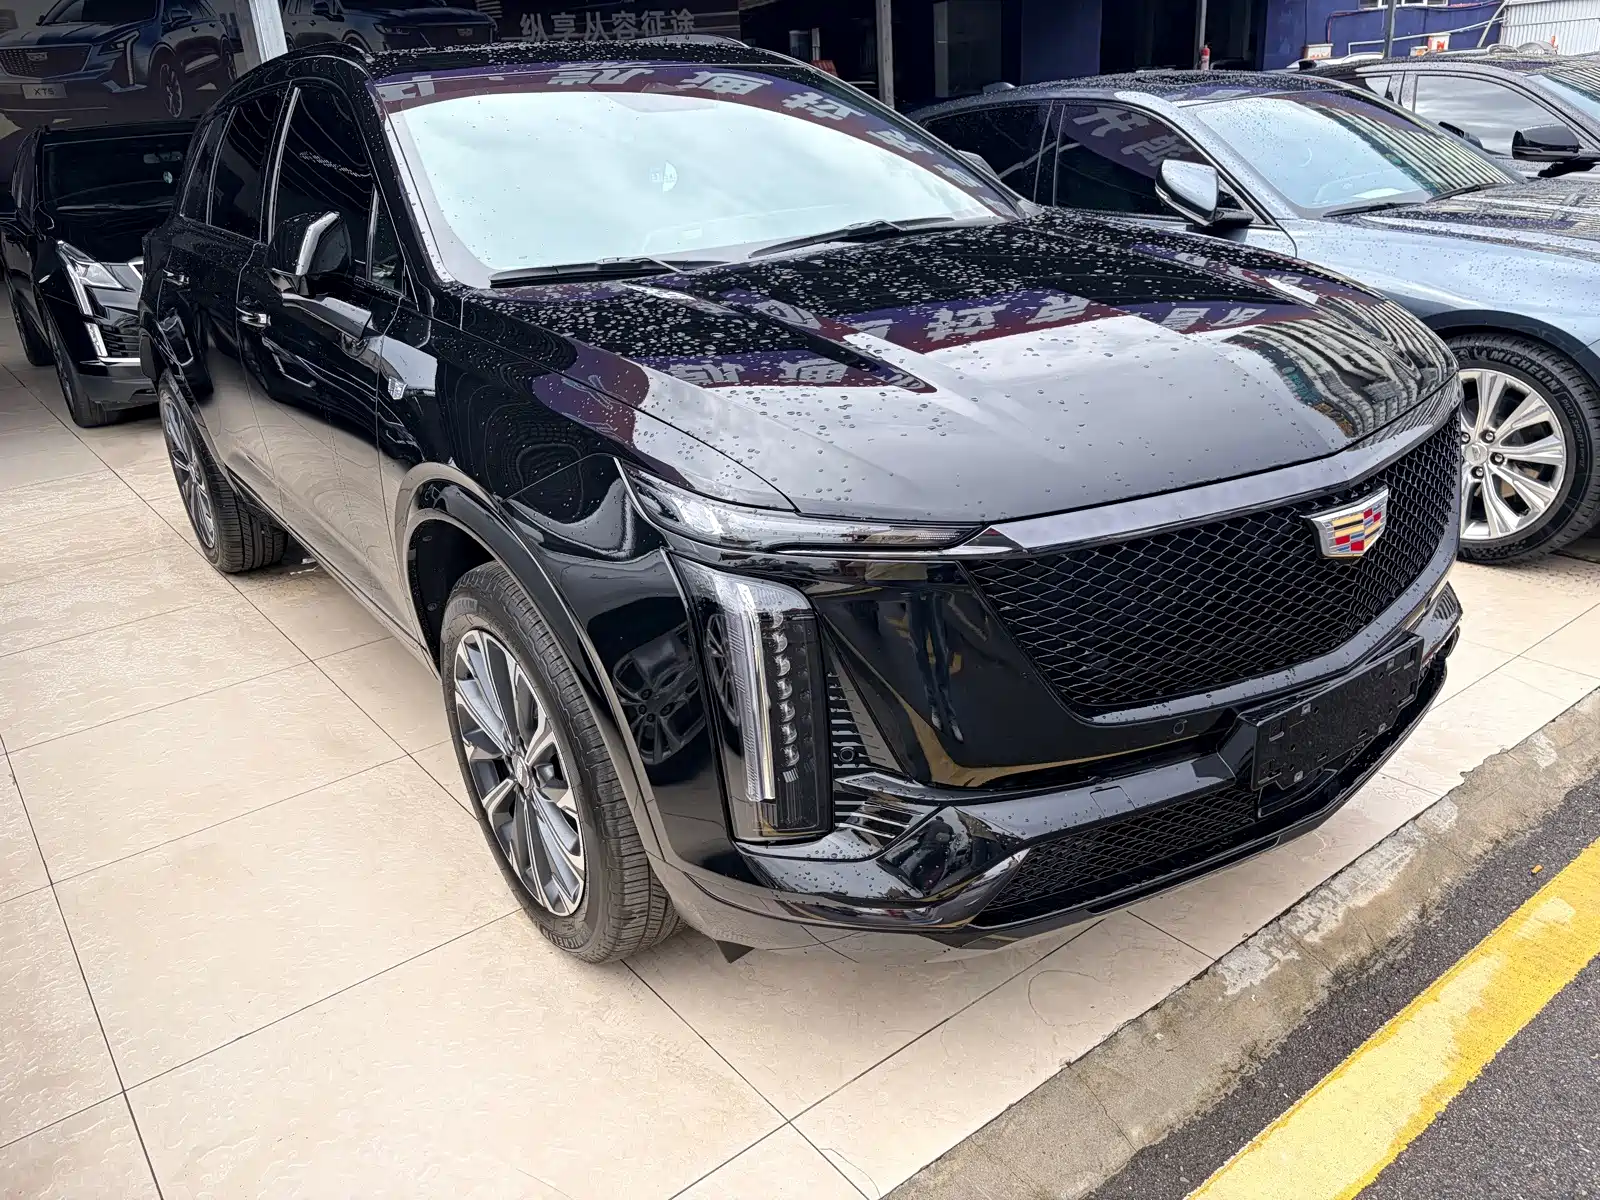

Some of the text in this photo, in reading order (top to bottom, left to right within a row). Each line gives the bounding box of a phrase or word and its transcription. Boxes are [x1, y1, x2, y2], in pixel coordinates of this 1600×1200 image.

[519, 8, 696, 42] 纵享从容征途
[1492, 350, 1560, 392] MICHELIN
